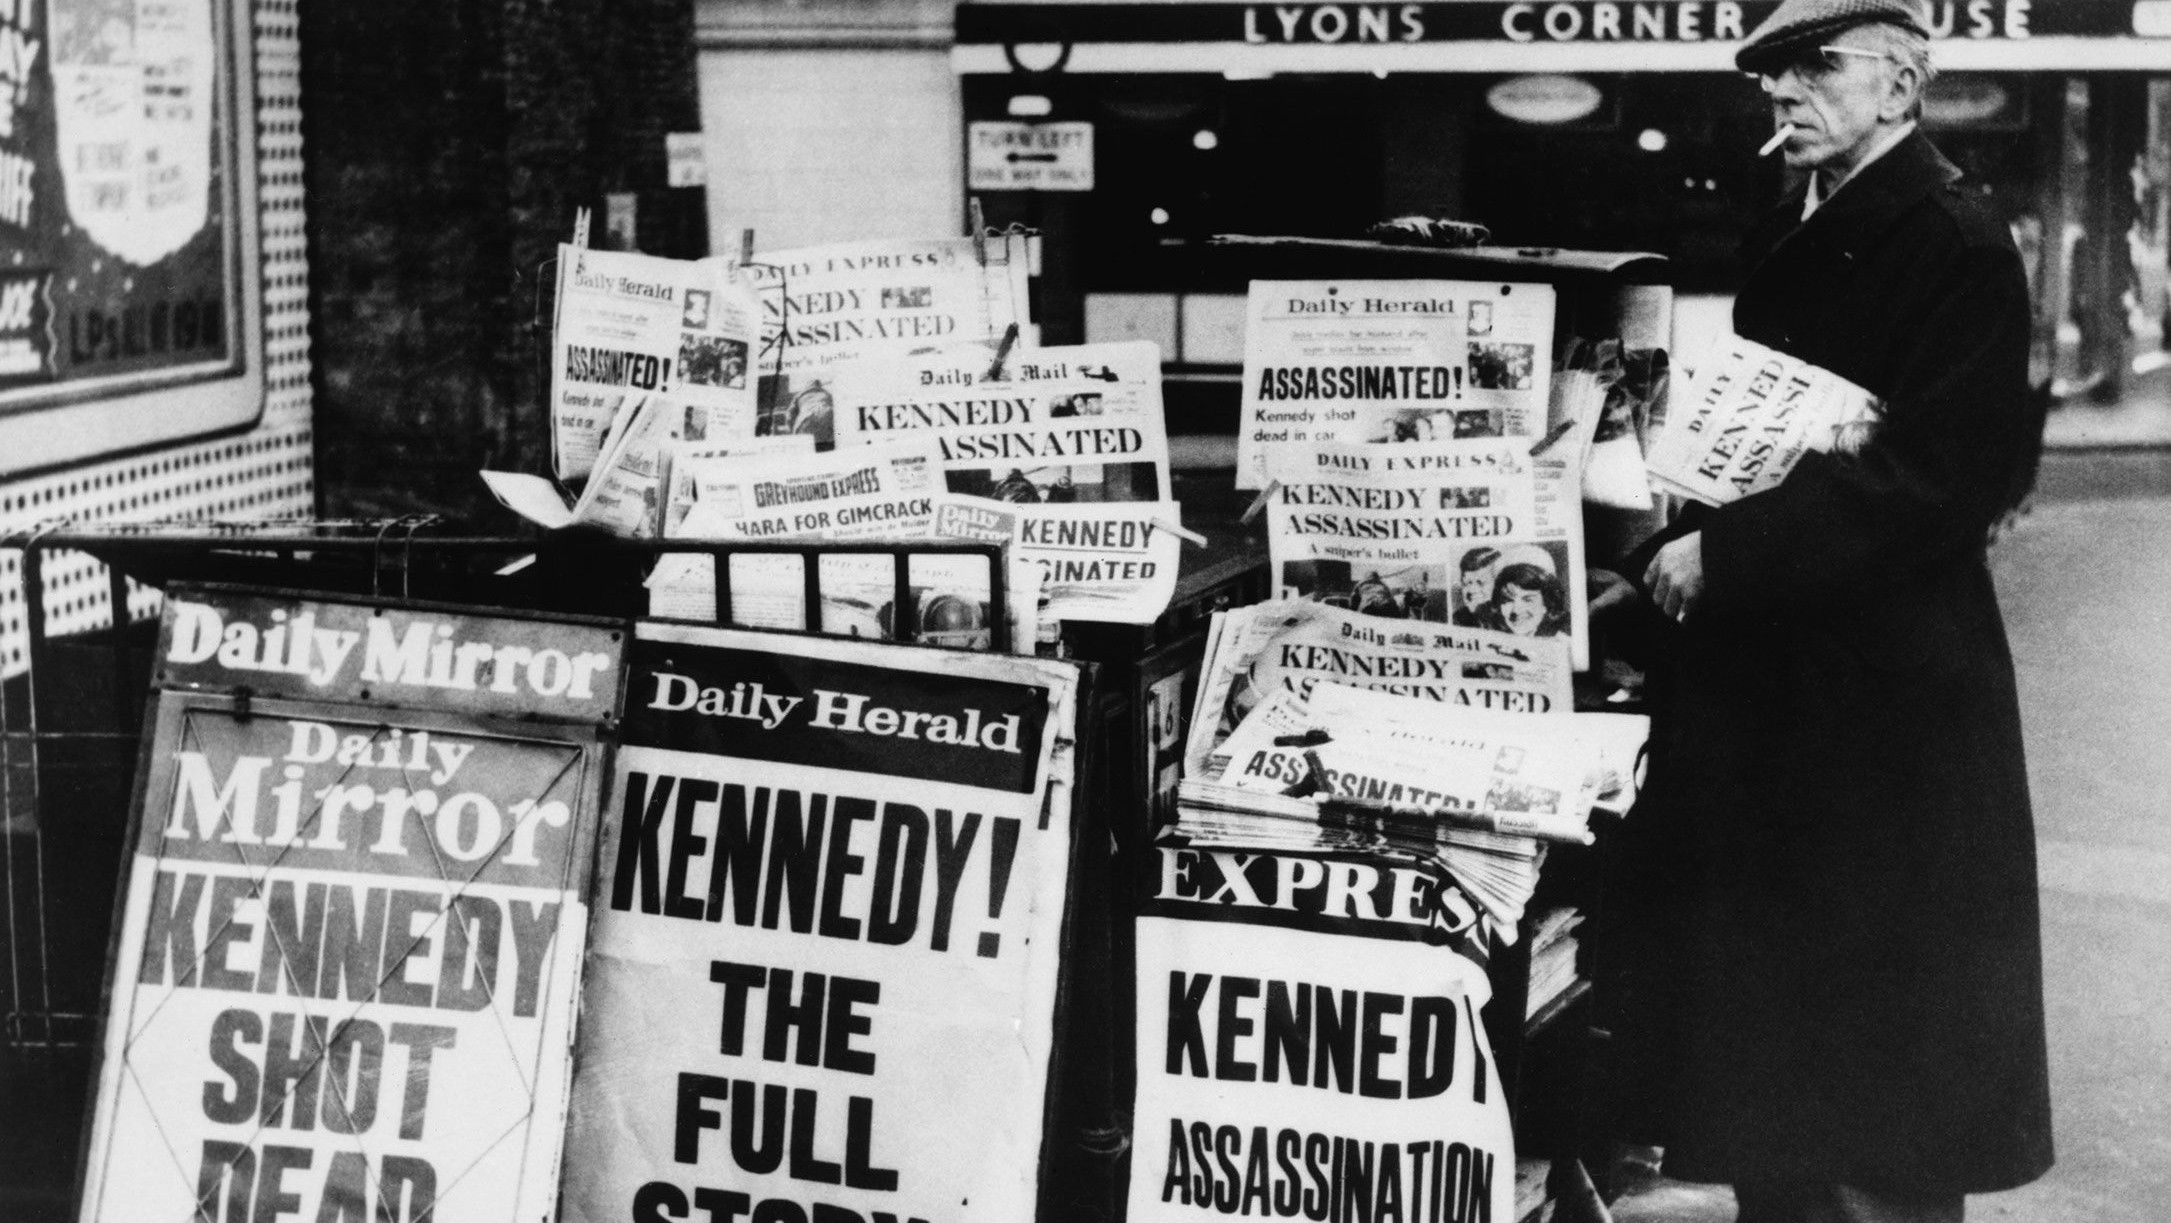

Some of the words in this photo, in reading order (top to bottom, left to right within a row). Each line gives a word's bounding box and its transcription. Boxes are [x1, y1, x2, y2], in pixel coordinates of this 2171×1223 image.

[1243, 7, 1425, 44] LYONS
[1501, 2, 1745, 42] CORNER
[1923, 0, 2032, 39] USE
[826, 251, 940, 274] EXPRESS
[1287, 297, 1356, 316] Daily
[1363, 297, 1456, 315] Herald
[919, 368, 975, 390] Daily
[1018, 362, 1070, 383] Mail
[1258, 365, 1464, 401] ASSASSINATED!
[857, 397, 1037, 432] KENNEDY
[1254, 408, 1316, 424] Kennedy
[1323, 407, 1357, 422] shot
[1697, 359, 1786, 481] KENNED
[937, 426, 1144, 462] ASSINATED
[1253, 427, 1288, 442] dead
[1294, 427, 1307, 442] in
[1314, 430, 1336, 443] car
[1316, 453, 1371, 472] DAILY
[1386, 453, 1498, 472] EXPRESS
[753, 480, 830, 509] GREYHOUND
[831, 466, 882, 498] EXPRESS
[1281, 483, 1428, 512] KENNEDY
[794, 510, 832, 531] FOR
[836, 498, 934, 527] GIMCRACK
[1284, 513, 1515, 542] ASSASSINATED
[1021, 518, 1153, 549] KENNEDY
[1309, 543, 1319, 556] A
[164, 601, 361, 688] Daily
[359, 615, 612, 699] Mirror
[1340, 621, 1387, 648] Daily
[1433, 633, 1482, 653] Mail
[1279, 643, 1452, 680] KENNEDY
[646, 671, 804, 731] Daily
[807, 688, 1023, 754] Herald
[281, 720, 477, 785] Daily
[162, 750, 573, 868] Mirror
[610, 770, 1023, 960] KENNEDY!
[137, 868, 566, 1019] KENNEDY
[708, 959, 882, 1077] THE
[200, 1008, 460, 1141] SHOT
[673, 1070, 900, 1193] FULL
[194, 1137, 440, 1223] DEAD
[1160, 1117, 1496, 1223] ASSASSINATION
